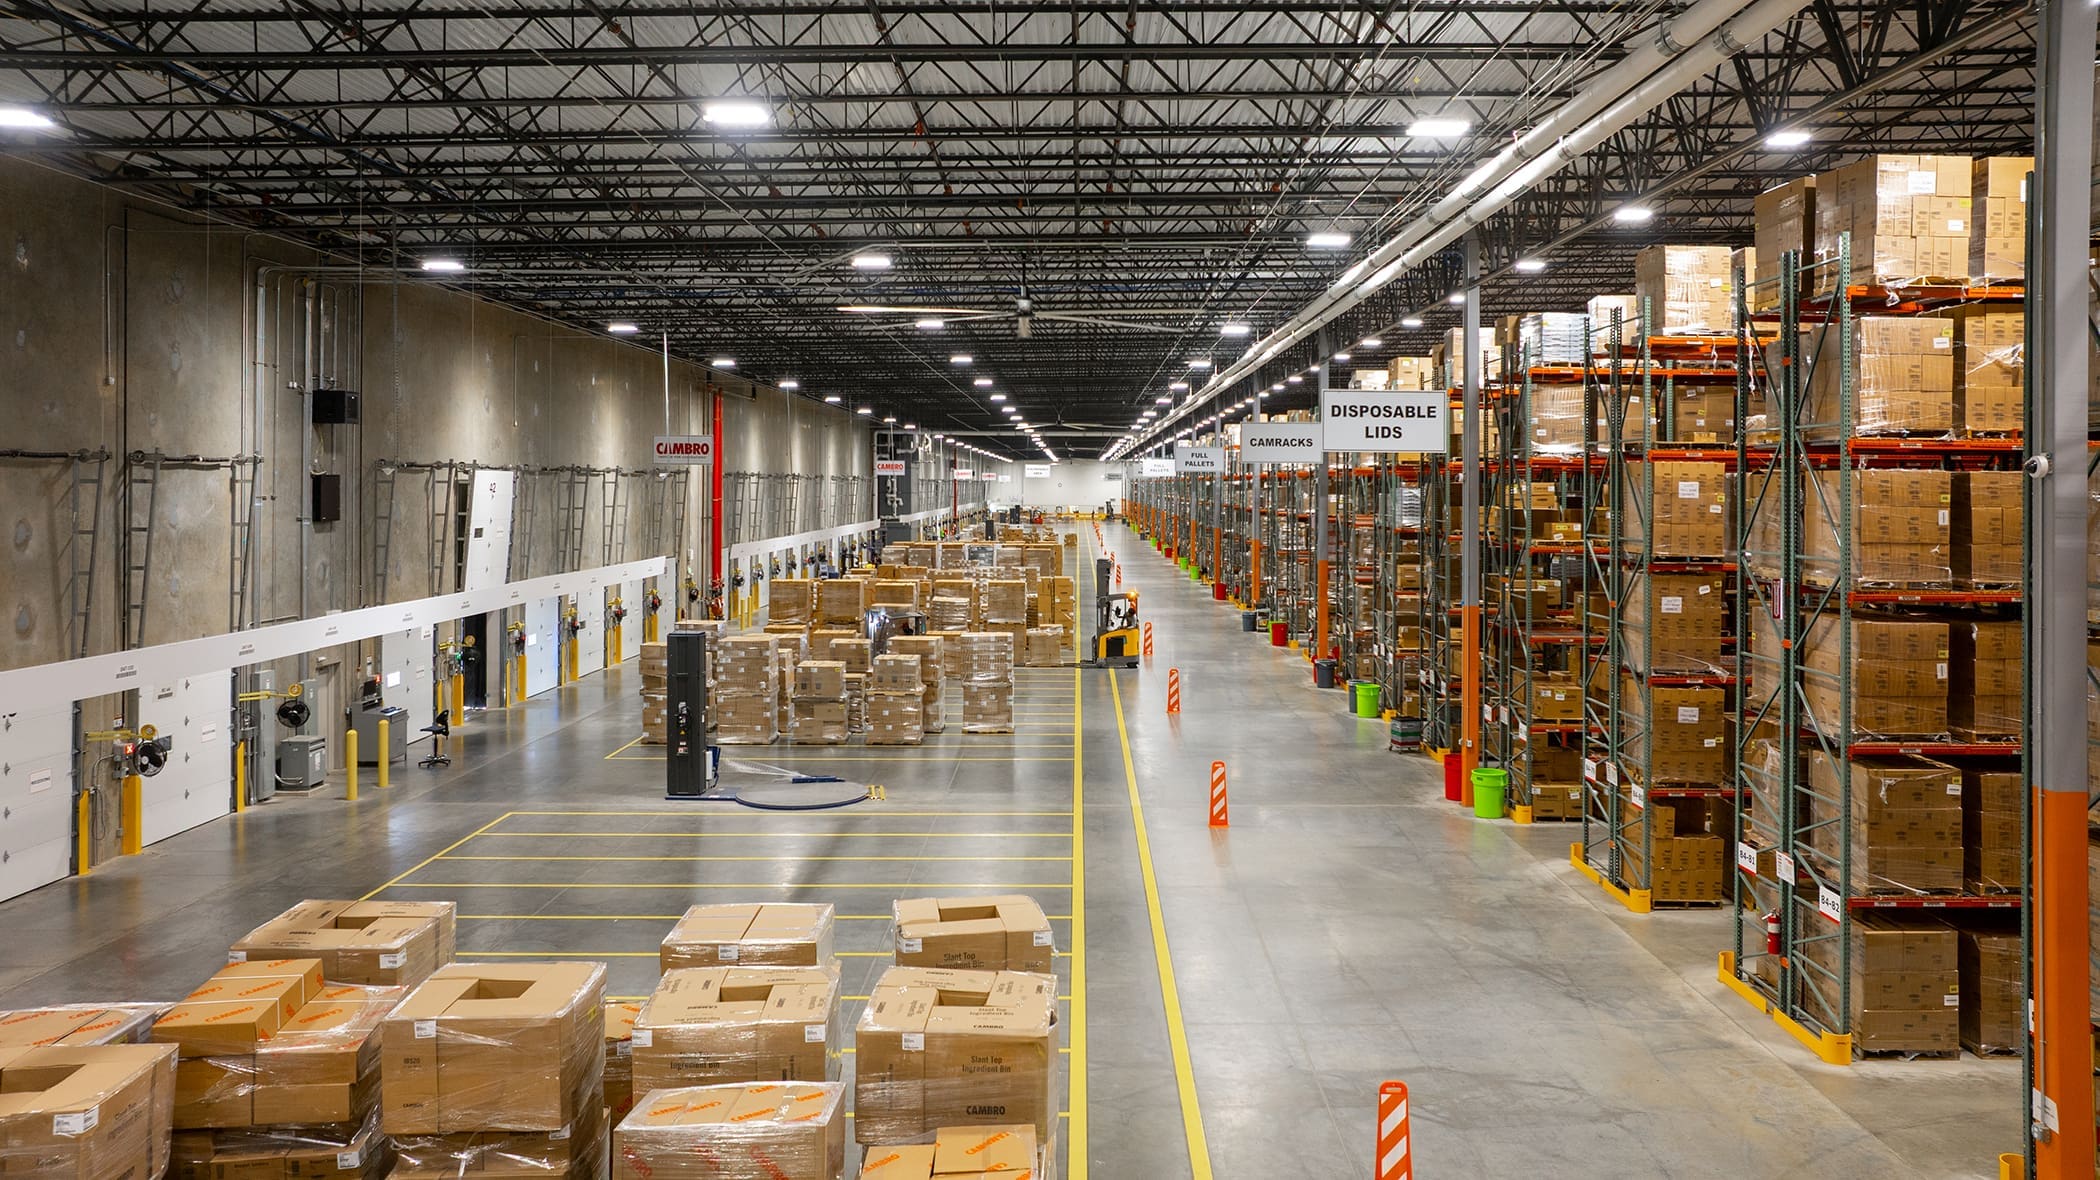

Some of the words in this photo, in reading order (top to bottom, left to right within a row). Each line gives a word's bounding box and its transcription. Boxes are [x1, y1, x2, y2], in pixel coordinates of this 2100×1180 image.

[1331, 404, 1437, 419] DISPOSABLE
[1365, 426, 1403, 440] LIDS
[1250, 438, 1313, 448] CAMRACKS
[656, 442, 710, 455] CAMBRO
[877, 463, 904, 471] CAMBRO
[943, 952, 962, 961] Slant
[963, 952, 976, 960] Top
[204, 1006, 254, 1023] CAMBRO
[970, 1055, 989, 1064] Slant
[991, 1055, 1003, 1065] Top
[962, 1064, 998, 1074] Ingredient
[1000, 1064, 1011, 1073] Bin
[966, 1105, 1006, 1116] CAMBRO
